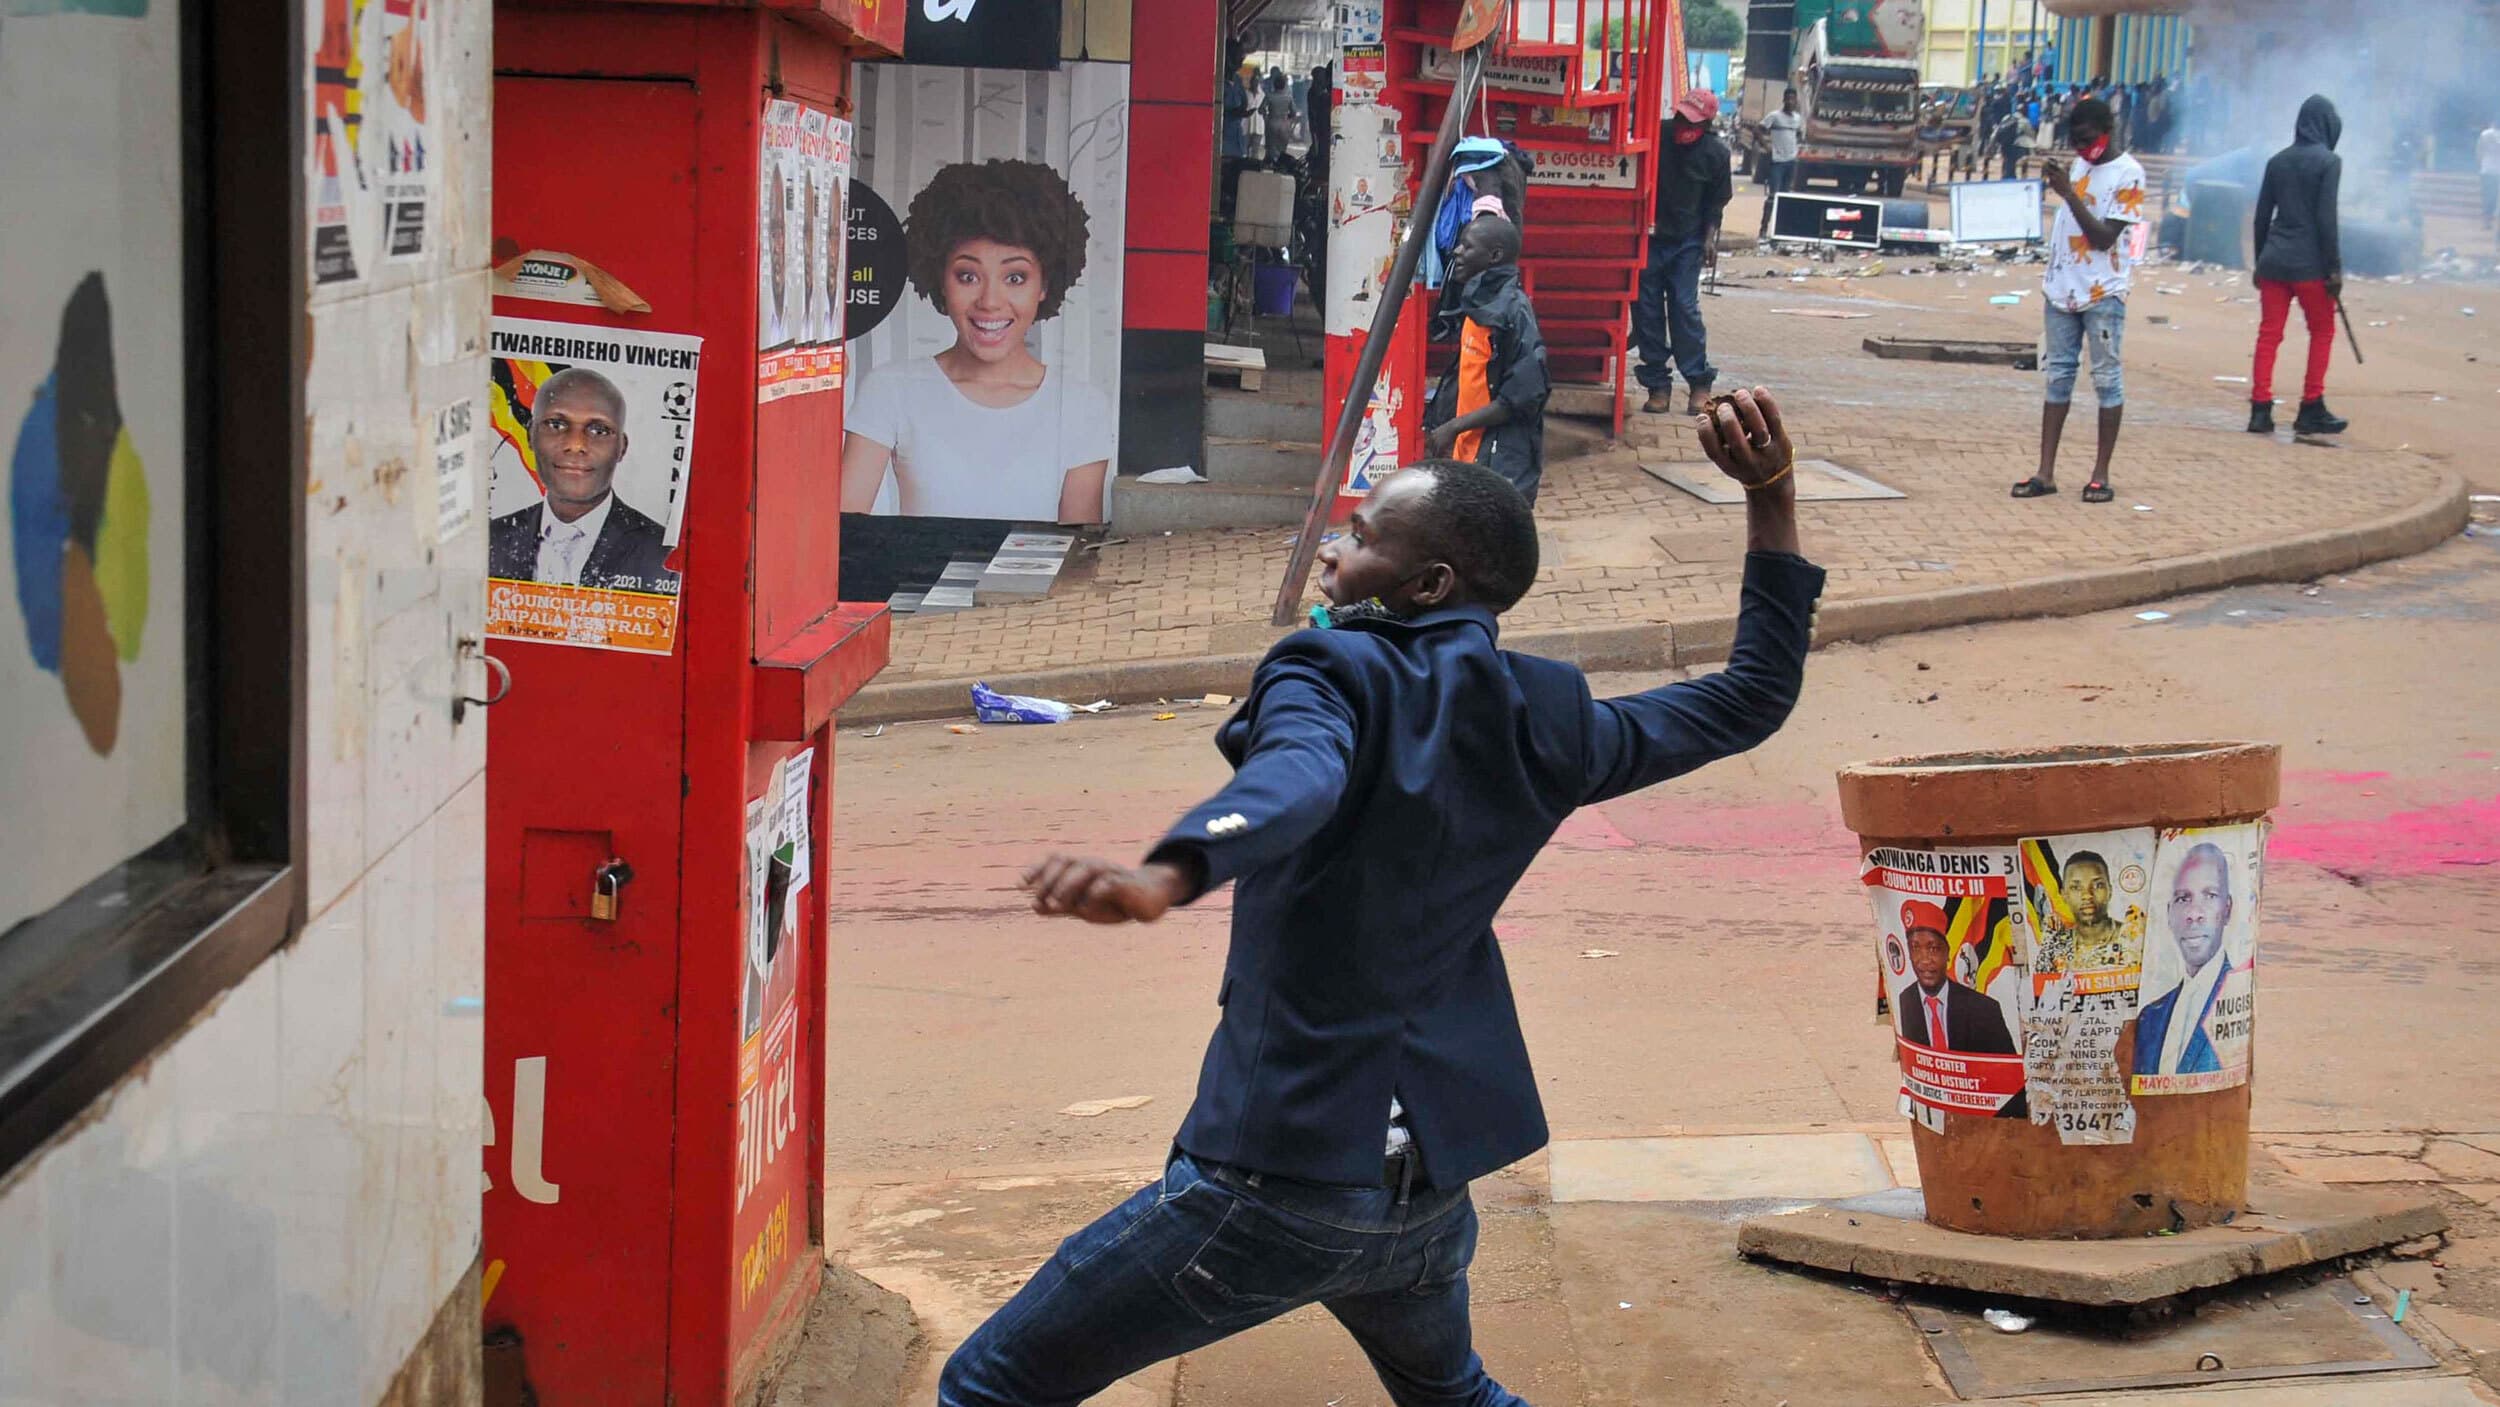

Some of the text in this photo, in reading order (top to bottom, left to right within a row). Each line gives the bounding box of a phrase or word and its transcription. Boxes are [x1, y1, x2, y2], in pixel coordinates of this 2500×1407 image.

[1511, 55, 1558, 73] GIGGLES
[1521, 75, 1530, 84] &
[1531, 76, 1551, 86] BAR
[1535, 151, 1616, 169] & GIGGLES
[1566, 171, 1576, 180] &
[1580, 172, 1606, 181] BAR
[852, 267, 873, 282] all
[491, 332, 699, 370] TWAREBIREHO VINCENT
[613, 574, 643, 589] 2021
[655, 579, 680, 594] 202
[493, 586, 617, 616] COUNCILLOR
[487, 606, 566, 630] AMPALA
[1869, 848, 1935, 873] MUWANGA
[1940, 854, 1990, 875] DENIS
[1882, 870, 1945, 895] COUNCILLOR
[1948, 877, 1965, 896] LC
[1968, 879, 1985, 896] III
[2090, 1027, 2111, 1036] APP
[1935, 1057, 1967, 1074] CENTER
[1941, 1073, 1980, 1091] DISTRICT
[741, 1188, 791, 1313] money
